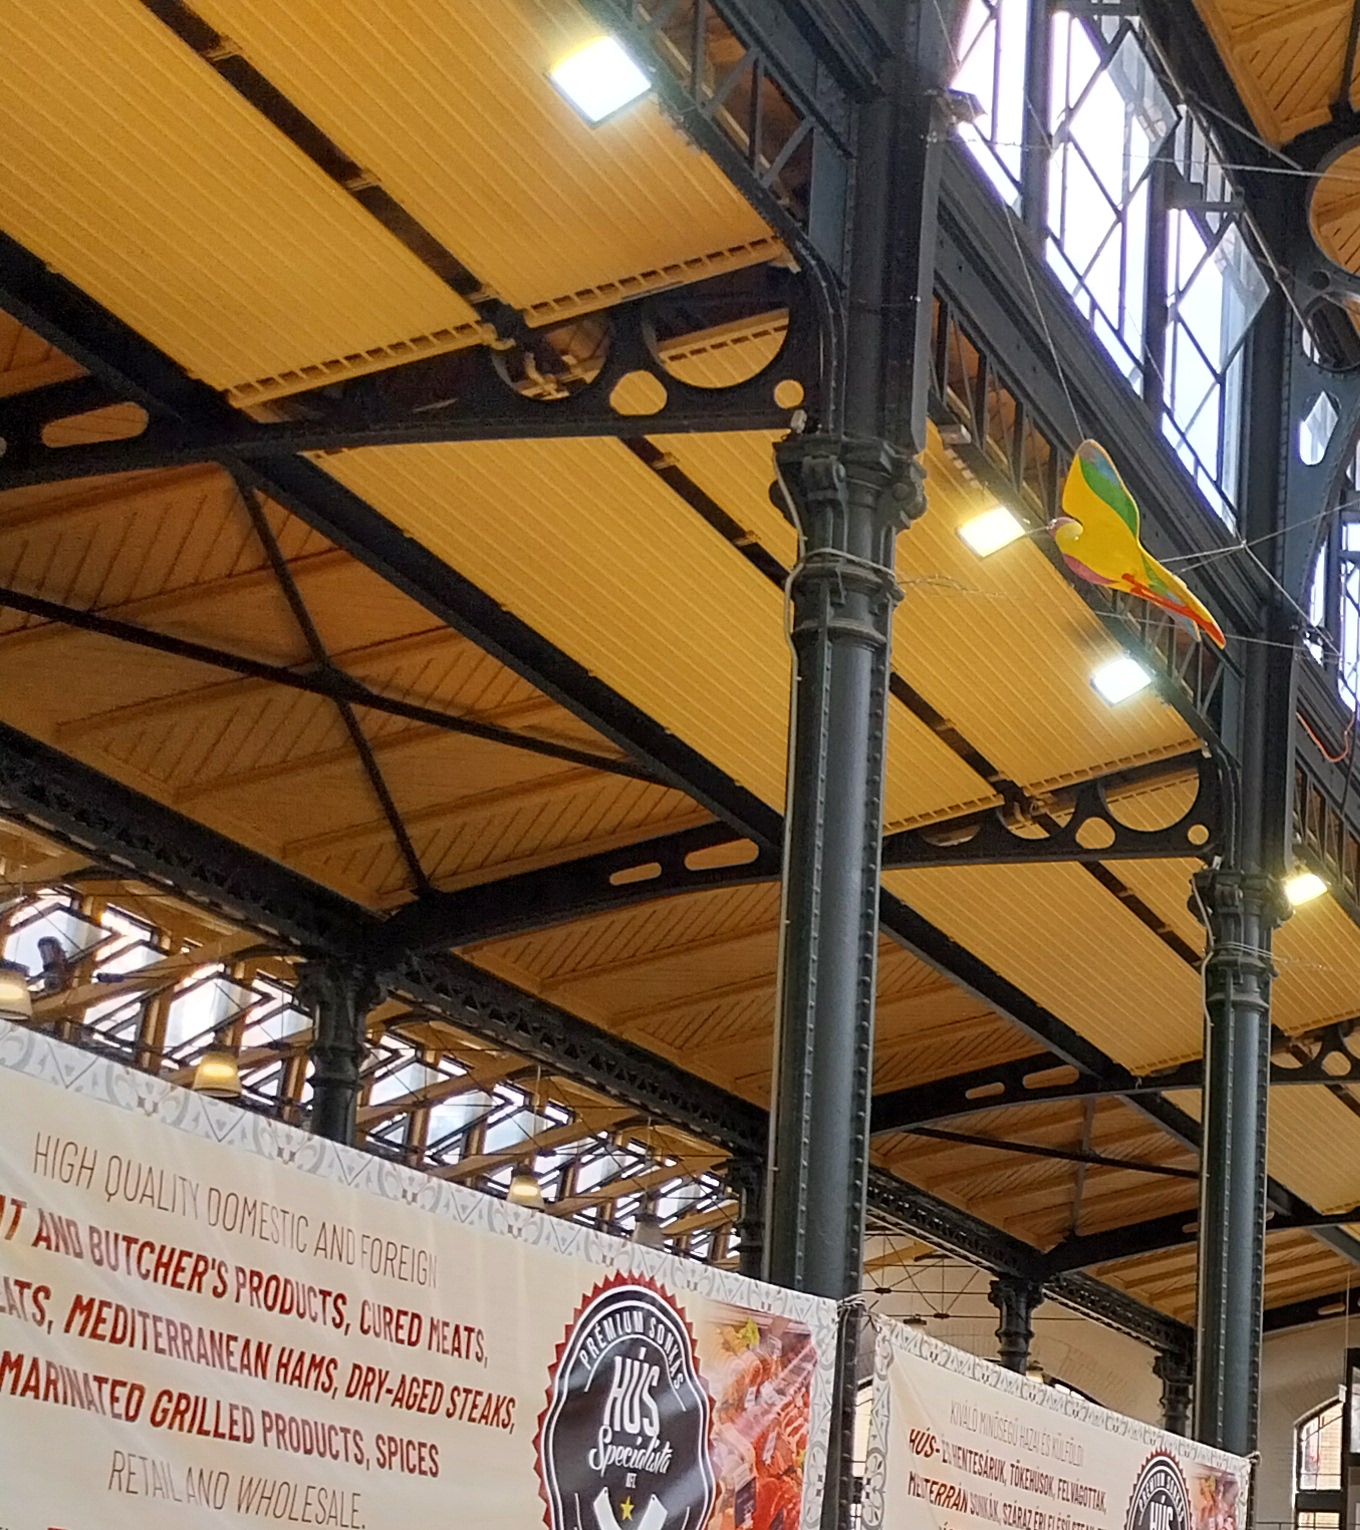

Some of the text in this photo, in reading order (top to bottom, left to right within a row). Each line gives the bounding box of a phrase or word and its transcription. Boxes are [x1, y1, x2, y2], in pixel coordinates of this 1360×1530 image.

[34, 1132, 437, 1287] HIGH QUALITY DOMESTIC AND FOREIGN
[32, 1208, 84, 1259] AND
[88, 1225, 228, 1298] BUTCHER'S
[235, 1266, 351, 1335] PRODUCTS,
[360, 1300, 422, 1347] CURED
[428, 1317, 488, 1368] MEATS,
[64, 1294, 272, 1379] MEDITERRANEAN
[275, 1347, 338, 1399] HAMS,
[345, 1363, 444, 1415] DRY-AGED
[446, 1386, 516, 1434] STEAKS,
[579, 1311, 684, 1389] PRÉMIUM SONKÁS
[603, 1347, 660, 1436] HÚS
[0, 1351, 439, 1477] MARINATED GRILLED PRODUCTS, SPICES
[589, 1424, 673, 1477] Specialista
[909, 1427, 940, 1458] HÚS-
[108, 1451, 365, 1529] RETAIL AND WHOLESALE.
